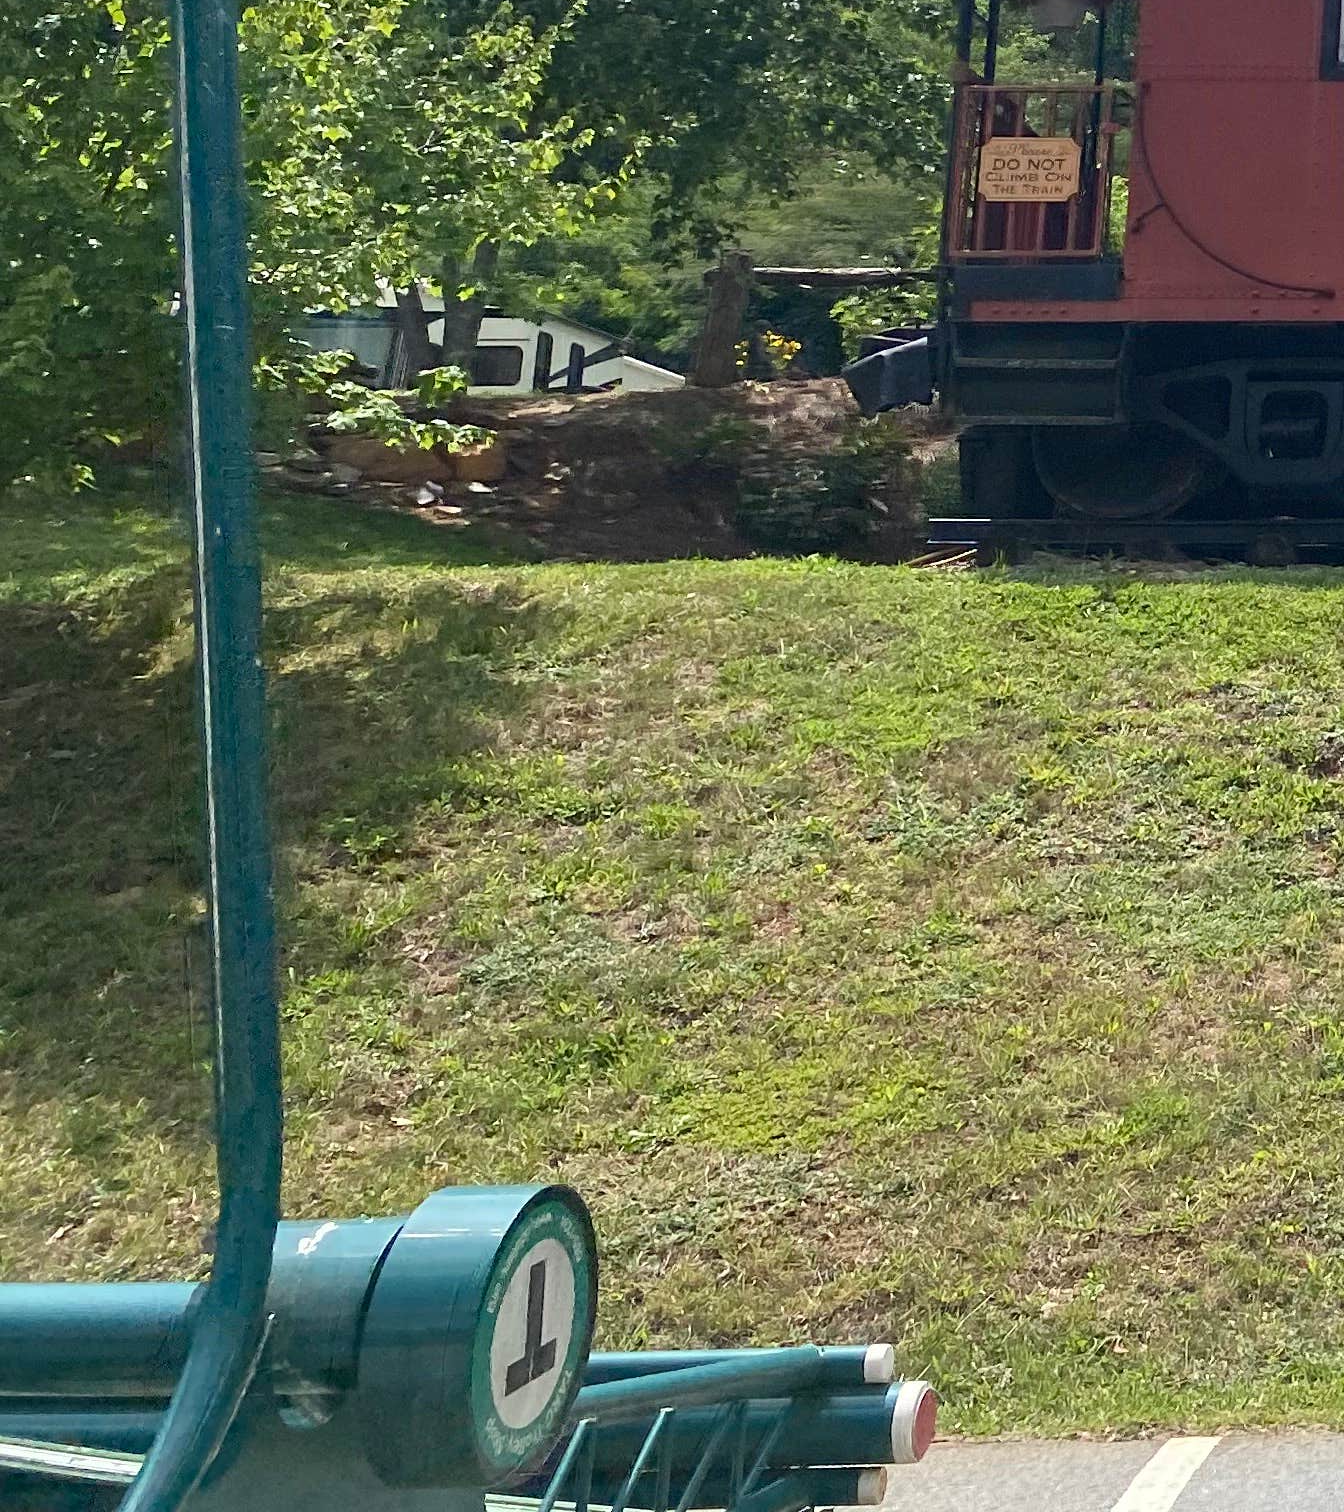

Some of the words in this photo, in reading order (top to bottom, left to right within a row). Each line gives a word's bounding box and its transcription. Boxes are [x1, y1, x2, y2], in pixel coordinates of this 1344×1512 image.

[992, 159, 1020, 171] DO
[1027, 159, 1066, 171] NOT
[504, 1259, 556, 1397] T
